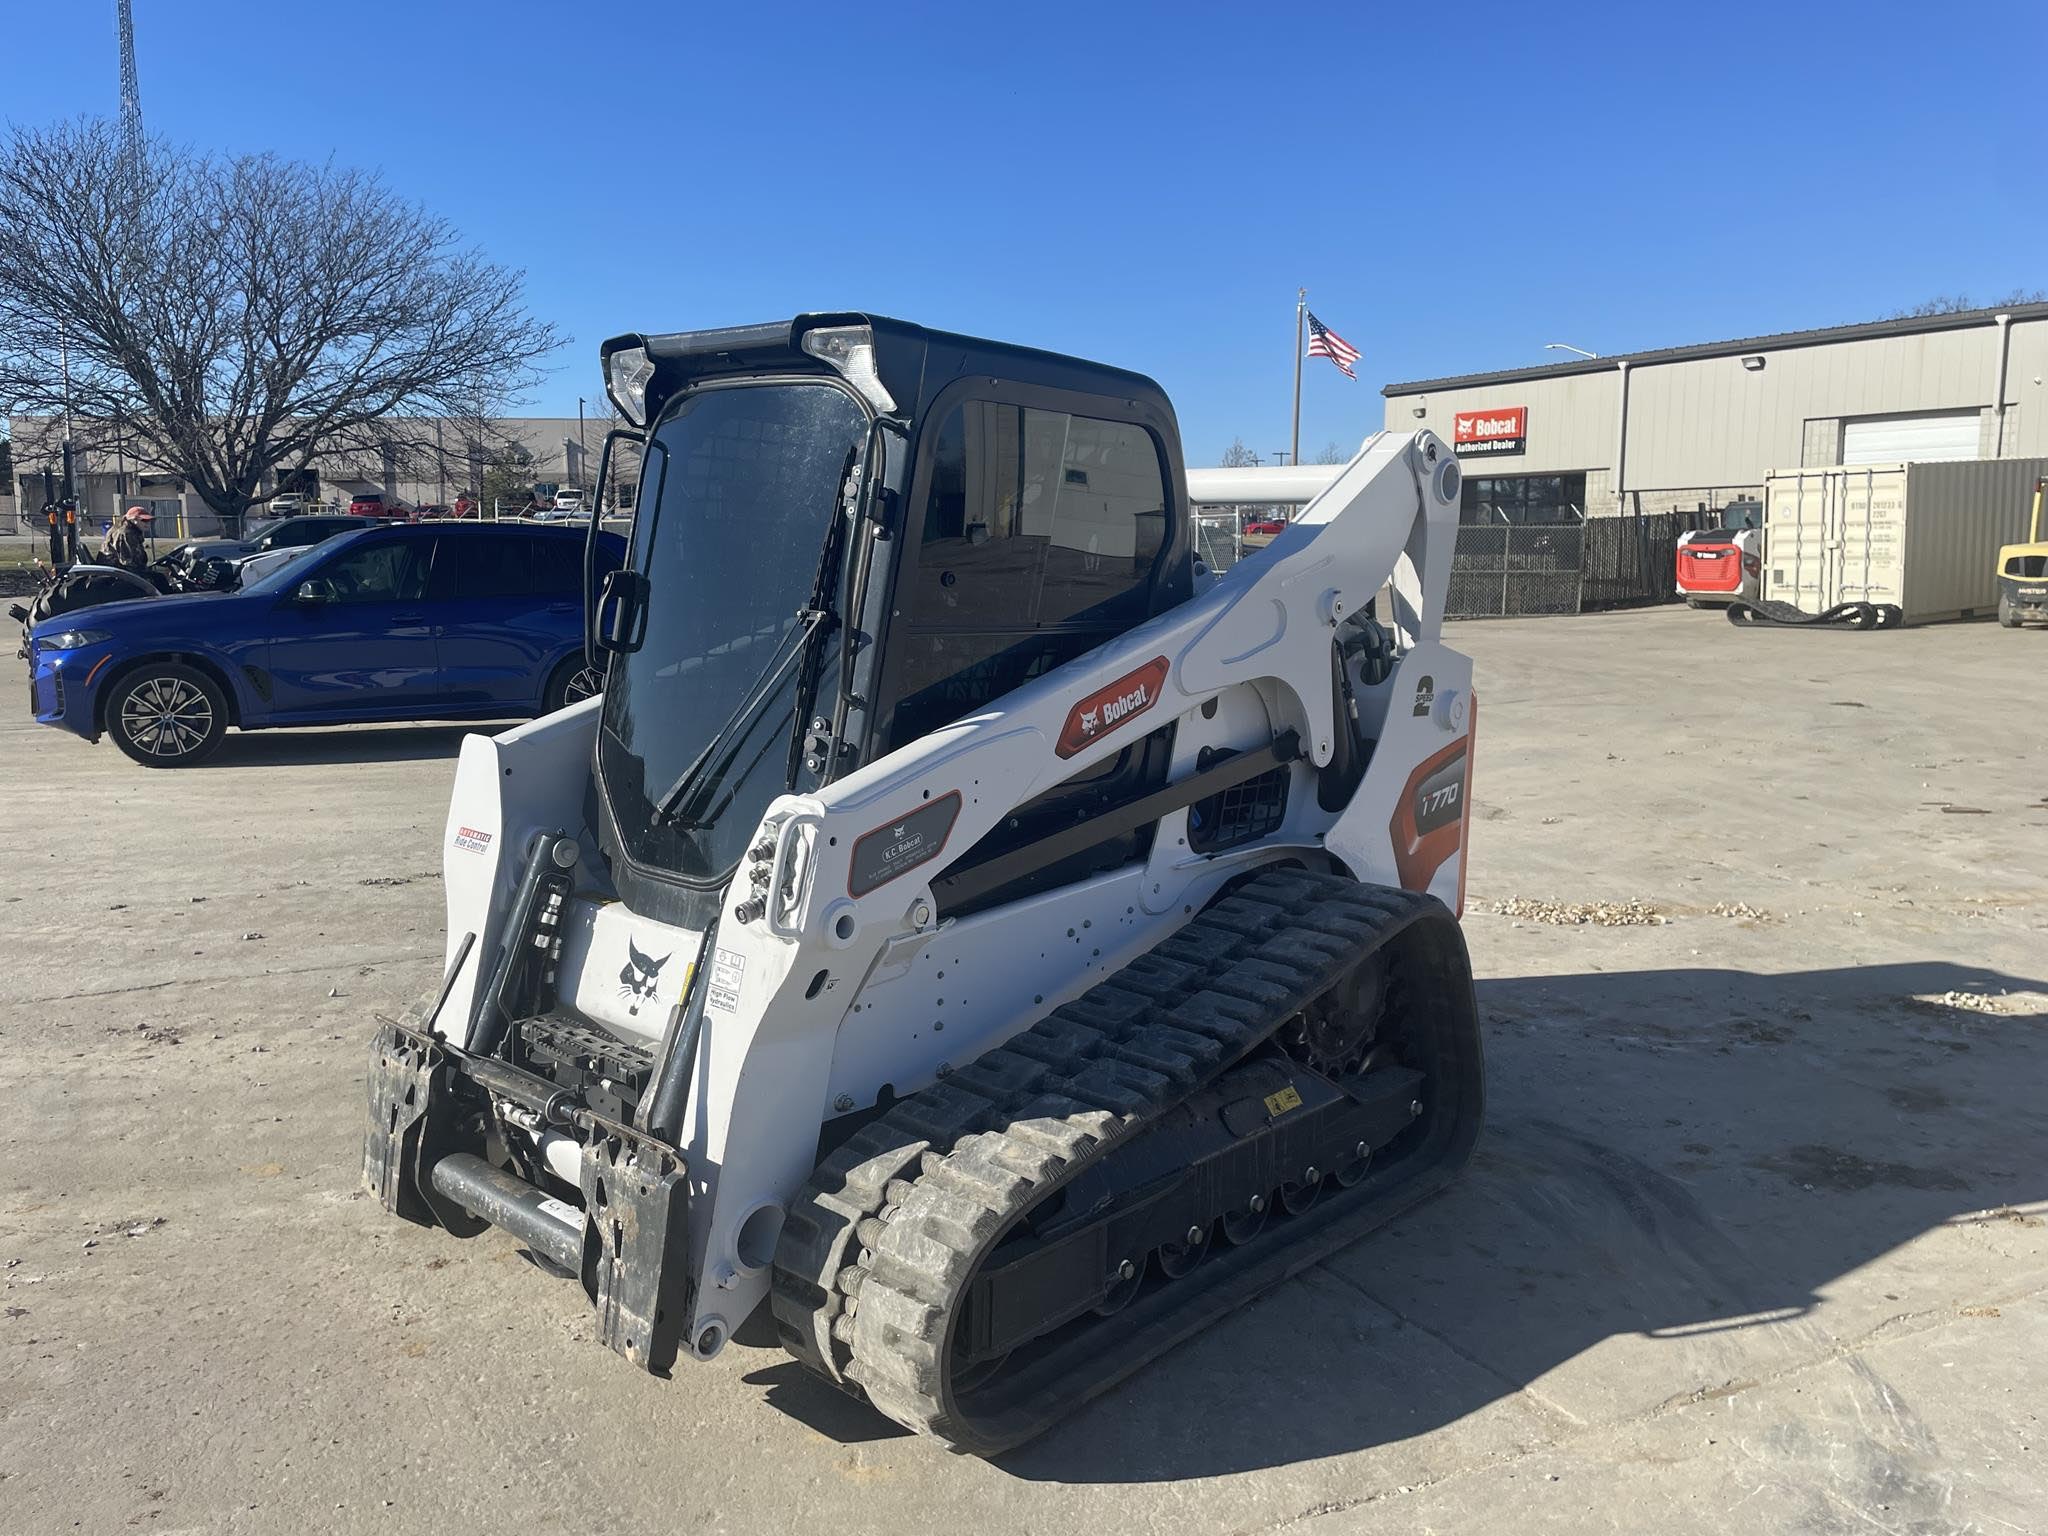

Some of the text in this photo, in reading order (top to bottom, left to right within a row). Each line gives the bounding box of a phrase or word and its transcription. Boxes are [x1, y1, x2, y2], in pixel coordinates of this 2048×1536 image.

[1476, 417, 1517, 436] Bobcat
[1456, 440, 1516, 452] Authorized Dealer
[1103, 684, 1147, 725] Bobcat
[1413, 675, 1434, 717] 2
[1415, 693, 1434, 703] SPEED
[459, 827, 491, 842] AUTOMATIC
[454, 836, 489, 853] Ride Control
[898, 836, 921, 853] Bobcat
[723, 992, 735, 1002] Flow
